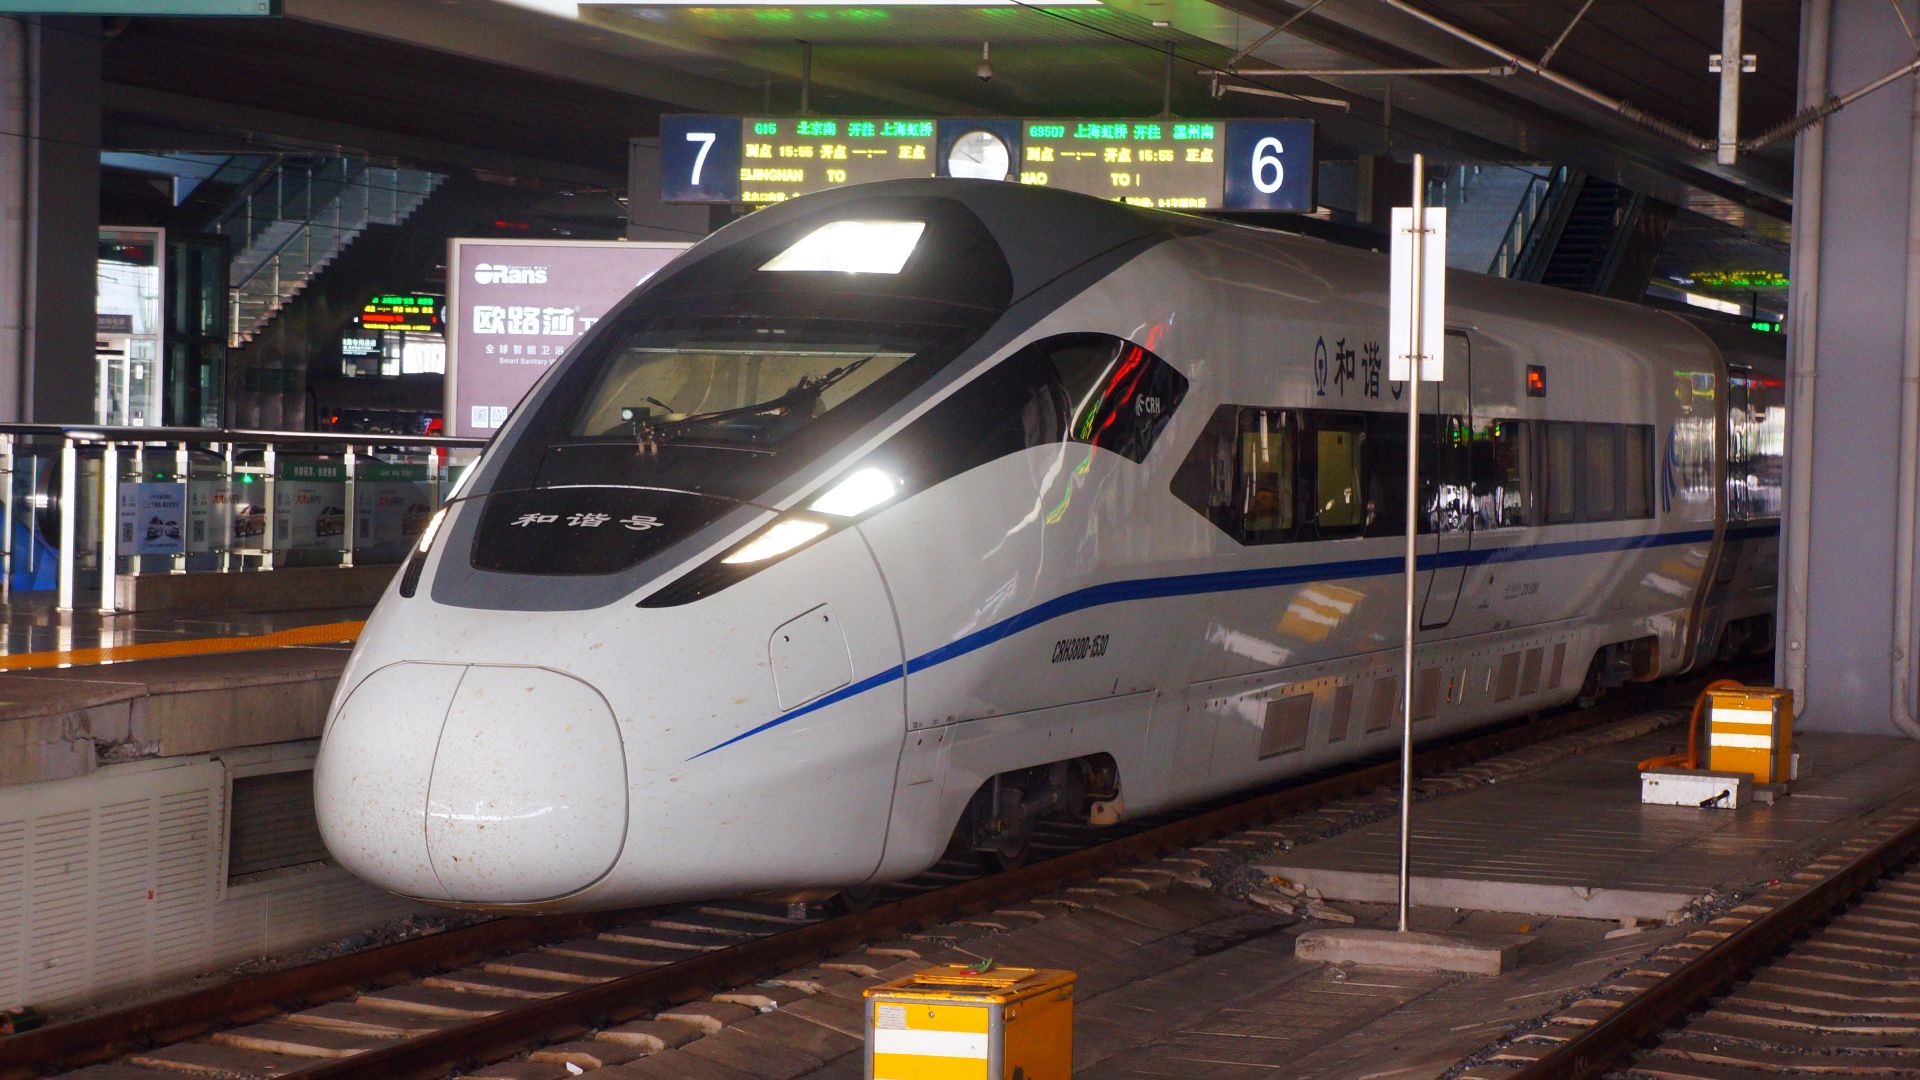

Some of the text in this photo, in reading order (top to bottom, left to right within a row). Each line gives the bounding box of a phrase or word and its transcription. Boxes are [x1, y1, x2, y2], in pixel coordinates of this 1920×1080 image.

[754, 121, 932, 137] G15 北京南 开往 上海虹桥
[1073, 124, 1128, 139] 上海虹桥
[1133, 125, 1161, 140] 开往
[686, 132, 716, 185] 7
[745, 144, 772, 159] 到点
[820, 144, 847, 159] 开点
[898, 145, 925, 160] 正点
[1026, 147, 1054, 162] 到点
[1104, 148, 1131, 163] 开点
[1186, 148, 1214, 163] 正点
[1251, 136, 1284, 194] 6
[826, 169, 847, 182] TO
[1110, 172, 1131, 186] TO
[520, 358, 548, 367] Sanitary
[1333, 336, 1403, 400] 和谐
[1145, 396, 1161, 414] CRH
[510, 512, 665, 531] 和谐号
